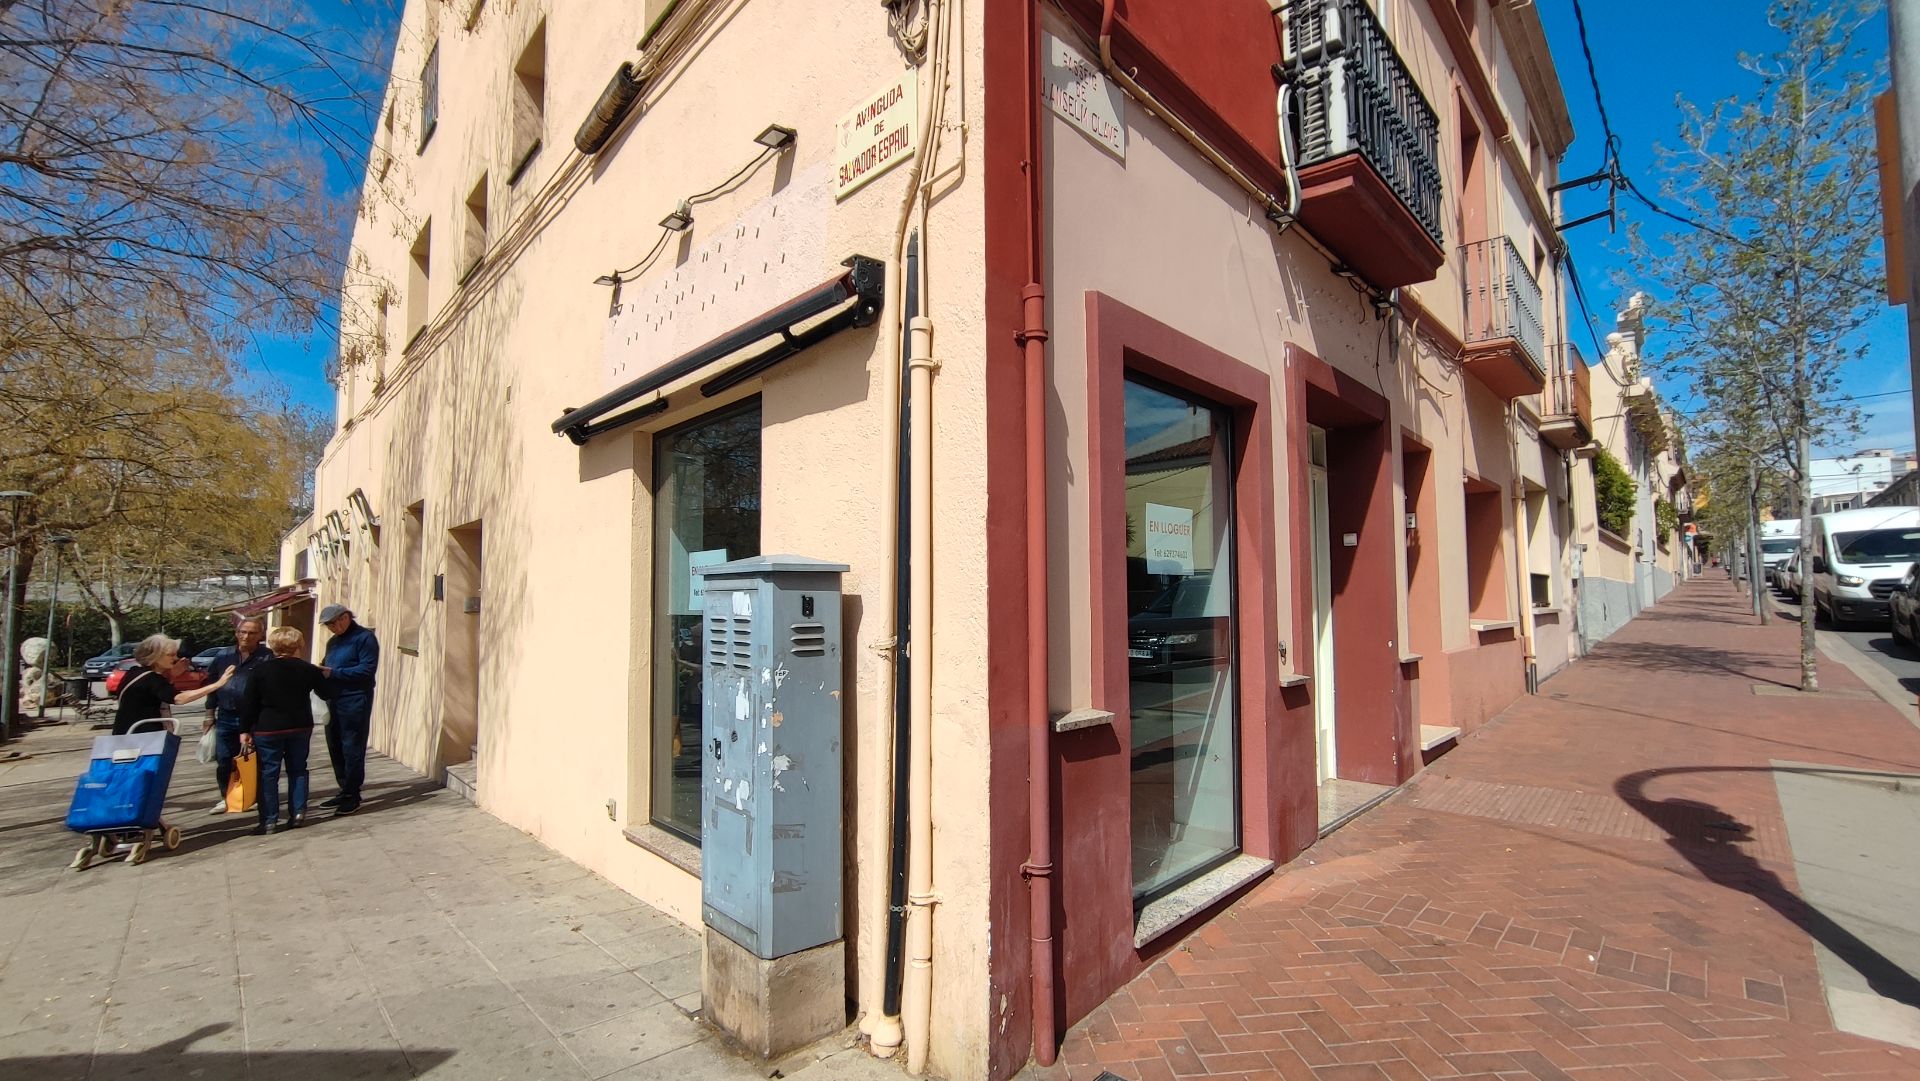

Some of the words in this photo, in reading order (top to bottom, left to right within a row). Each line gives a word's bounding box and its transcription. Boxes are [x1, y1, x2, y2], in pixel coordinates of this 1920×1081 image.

[1075, 81, 1087, 103] DE
[856, 84, 903, 130] AVINGUDA
[874, 120, 885, 136] DE
[1091, 112, 1119, 148] CLAVÉ
[839, 145, 877, 188] SALVADOR
[878, 123, 909, 163] ESPRIU
[1149, 520, 1159, 532] EN
[1161, 522, 1191, 536] LLOGUER
